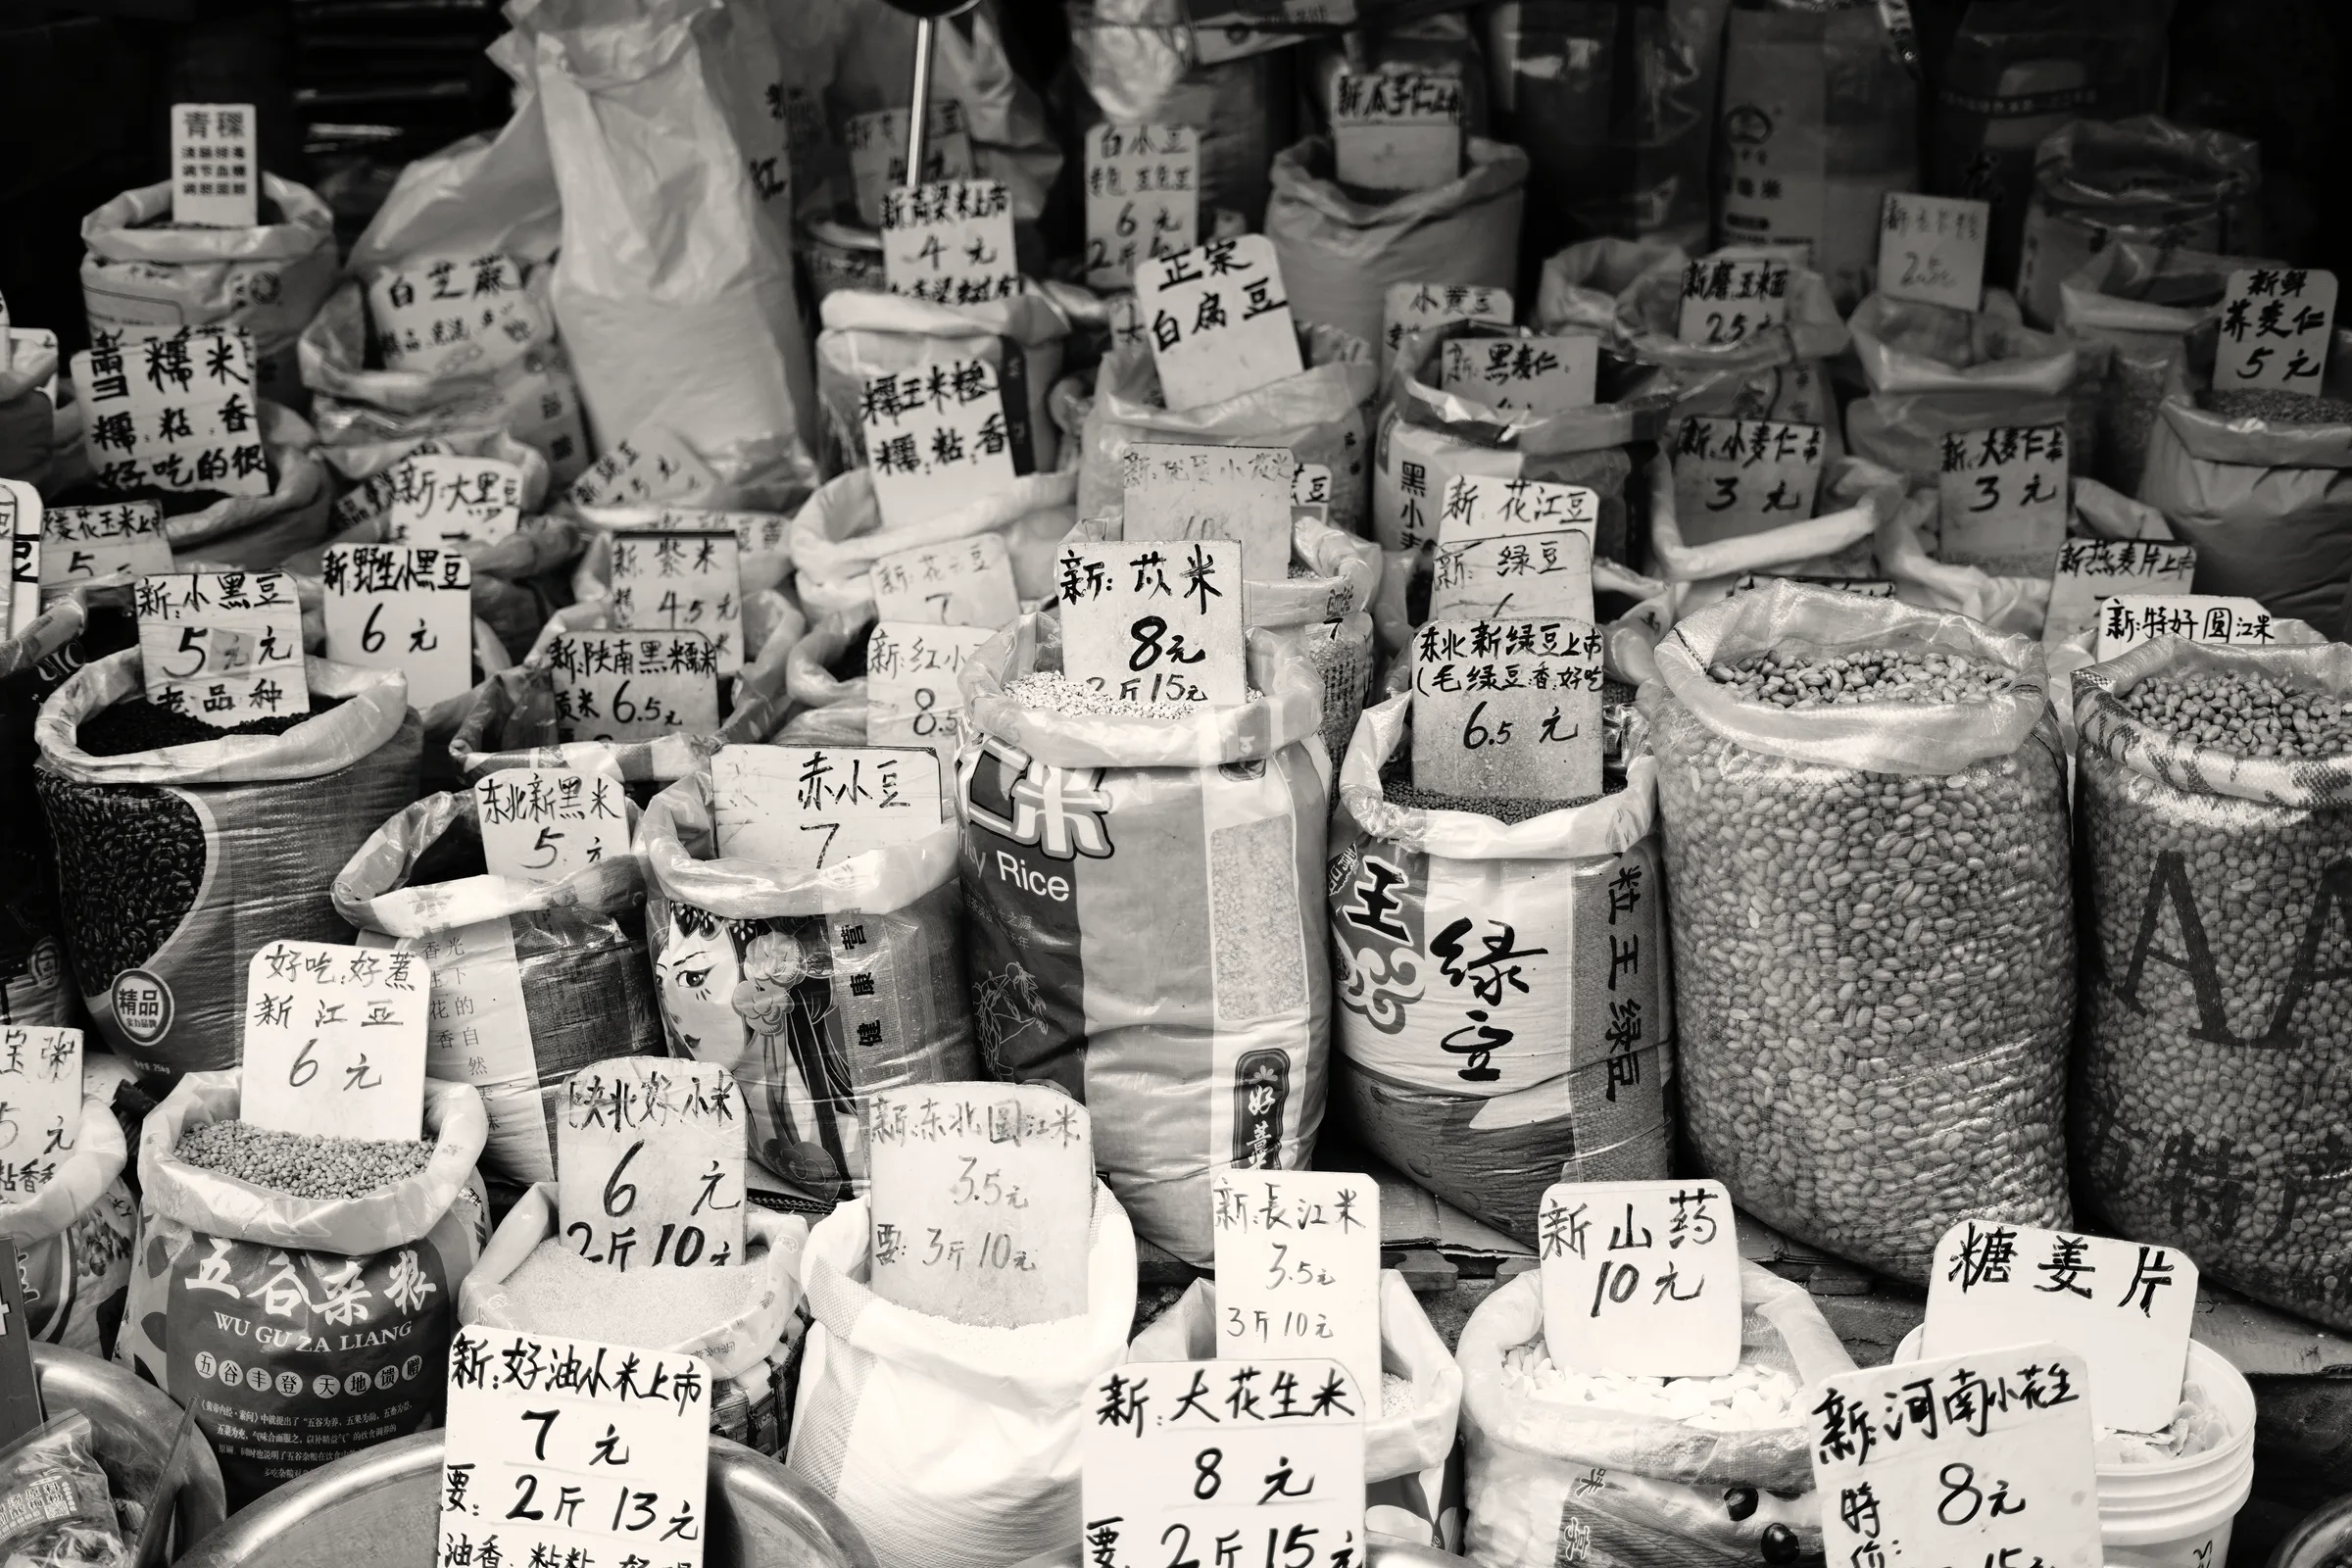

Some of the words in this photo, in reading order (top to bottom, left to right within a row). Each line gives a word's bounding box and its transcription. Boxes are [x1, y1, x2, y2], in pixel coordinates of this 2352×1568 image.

[1157, 239, 1256, 292] 正宗
[2245, 270, 2307, 298] 新鲜
[2222, 298, 2325, 343] 荞麦仁
[2233, 345, 2324, 381] 5元
[97, 443, 269, 491] 好吃的很
[1706, 476, 1801, 513] 3元
[1967, 474, 2057, 514] 3元
[361, 602, 438, 655] 6元
[870, 628, 993, 680] 新:红小
[1128, 615, 1203, 672] 8元
[1417, 622, 1604, 668] 东北新绿豆上市
[612, 679, 683, 726] 6.5元
[1462, 700, 1587, 750] 6.5元
[477, 772, 625, 825] 东北新黑米
[797, 750, 909, 813] 赤小豆
[996, 850, 1070, 904] Rice
[117, 987, 161, 1017] 精品
[253, 992, 404, 1030] 新江豆
[289, 1037, 382, 1092] 6元
[604, 1139, 741, 1219] 6元
[950, 1155, 1030, 1208] 3.5元
[564, 1219, 733, 1268] 2斤10元
[923, 1226, 1038, 1272] 3斤10元
[1537, 1188, 1718, 1261] 新山药
[185, 1240, 438, 1328] 五谷杂粮
[1264, 1242, 1337, 1292] 3.5元
[1591, 1259, 1706, 1319] 10元
[1945, 1221, 2177, 1320] 糖姜片
[213, 1309, 251, 1336] WU
[254, 1324, 295, 1348] GU
[298, 1332, 340, 1354] ZA
[347, 1320, 415, 1352] LIANG
[1224, 1303, 1335, 1346] 3斤10元
[520, 1407, 629, 1468] 7元
[1193, 1446, 1315, 1507] 8元
[1936, 1460, 2026, 1528] 8元
[504, 1472, 701, 1539] 2斤13元
[1156, 1523, 1362, 1568] 2斤15元
